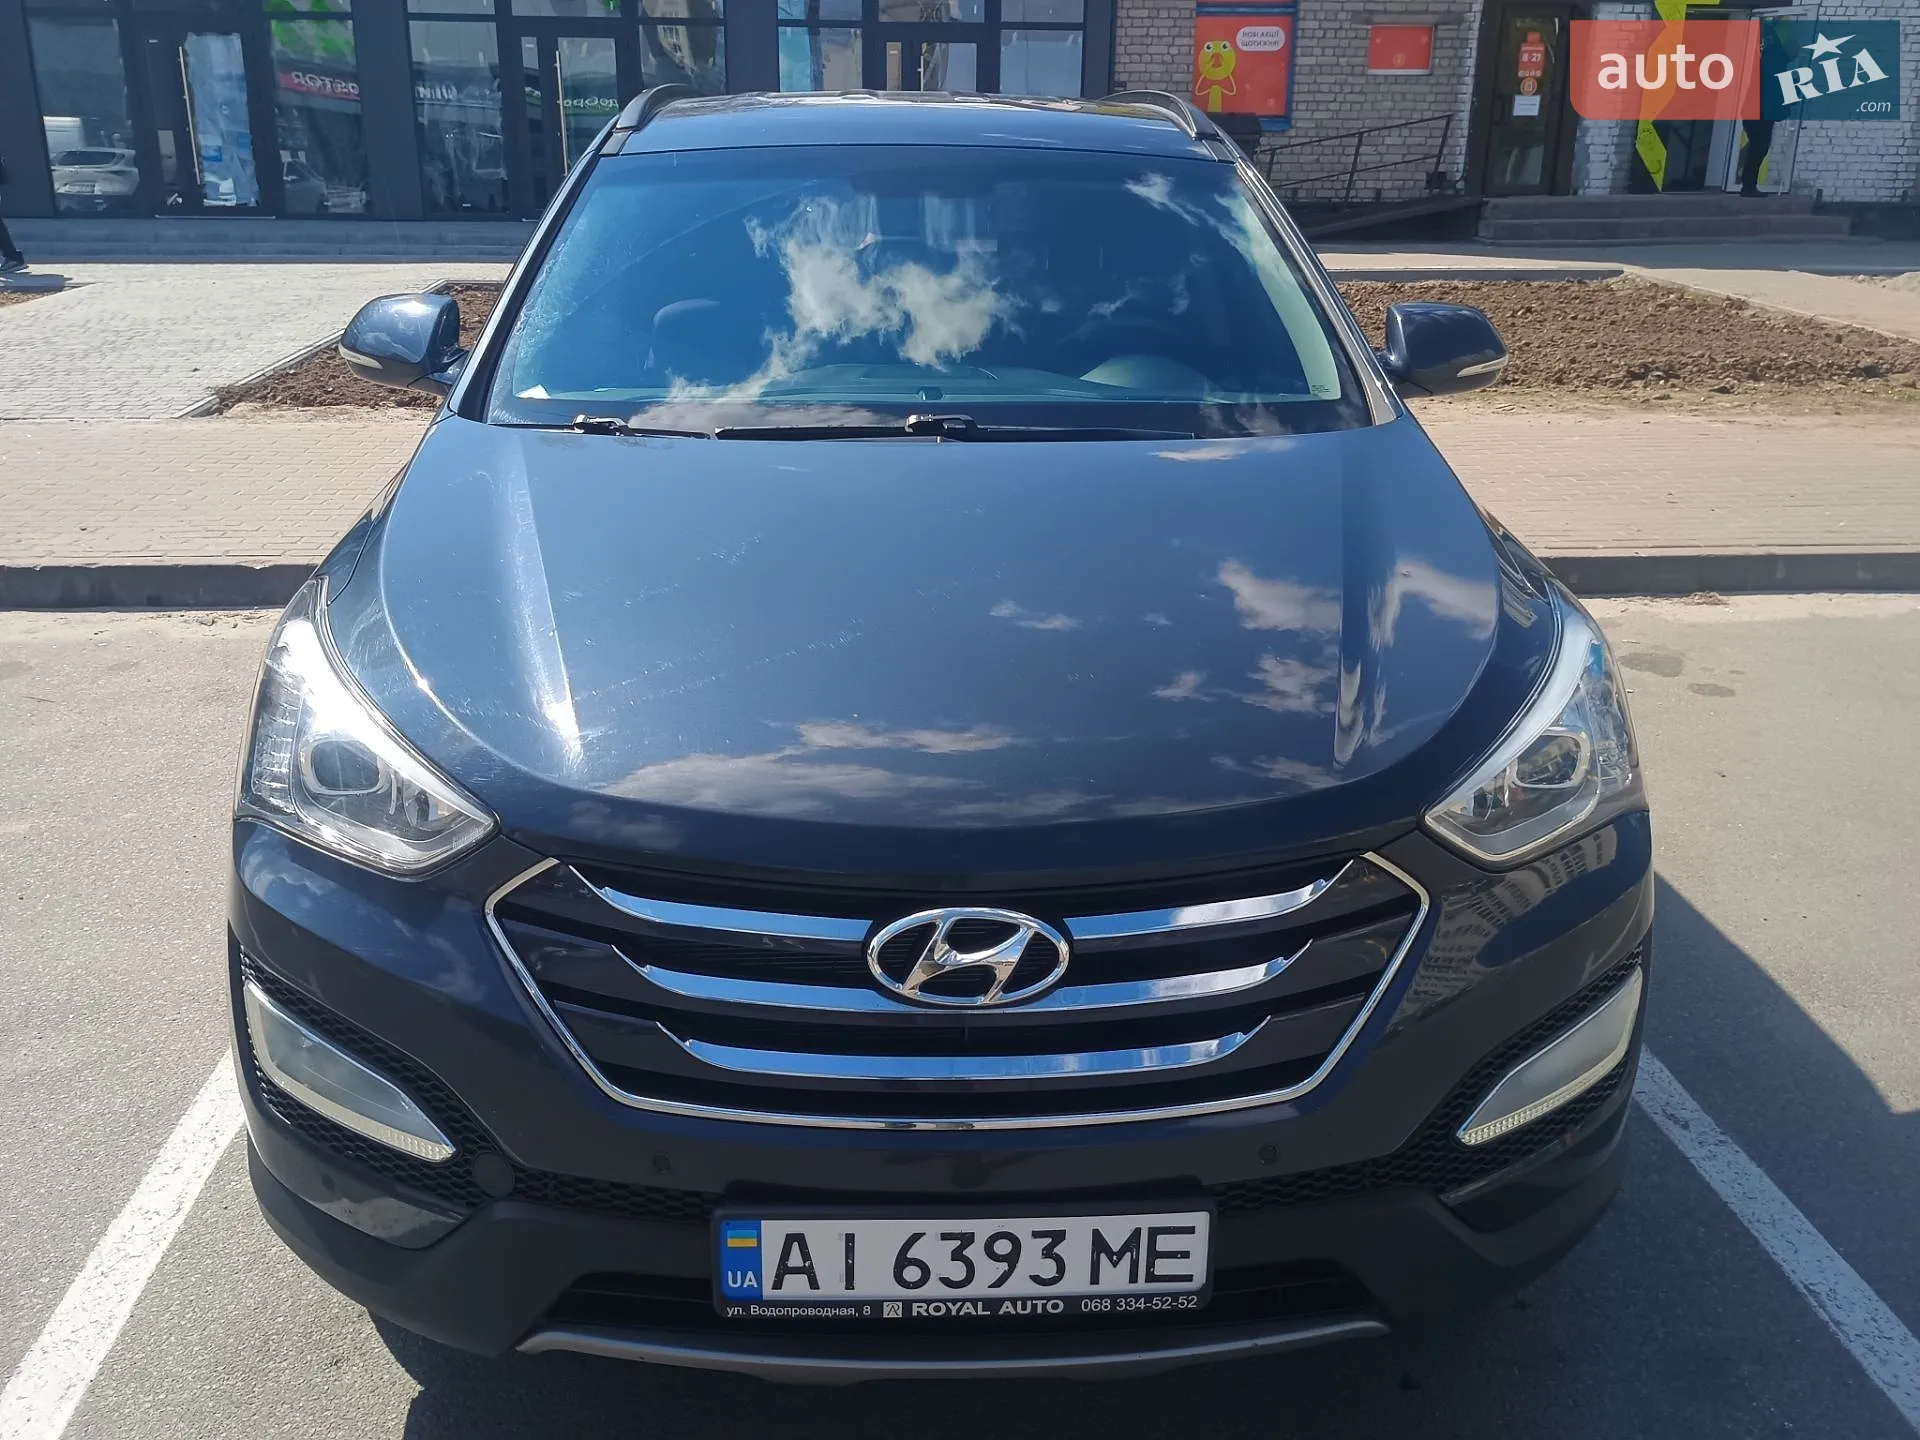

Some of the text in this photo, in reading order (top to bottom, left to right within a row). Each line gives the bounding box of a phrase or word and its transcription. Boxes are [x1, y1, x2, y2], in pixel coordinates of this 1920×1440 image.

[770, 1225, 1196, 1291] AI 6393 ME
[727, 1270, 758, 1288] UA
[726, 1304, 871, 1318] ул. Водопроводная, 8
[911, 1299, 1065, 1317] ROYAL AUTO
[1081, 1295, 1198, 1312] 068 334-52-52
